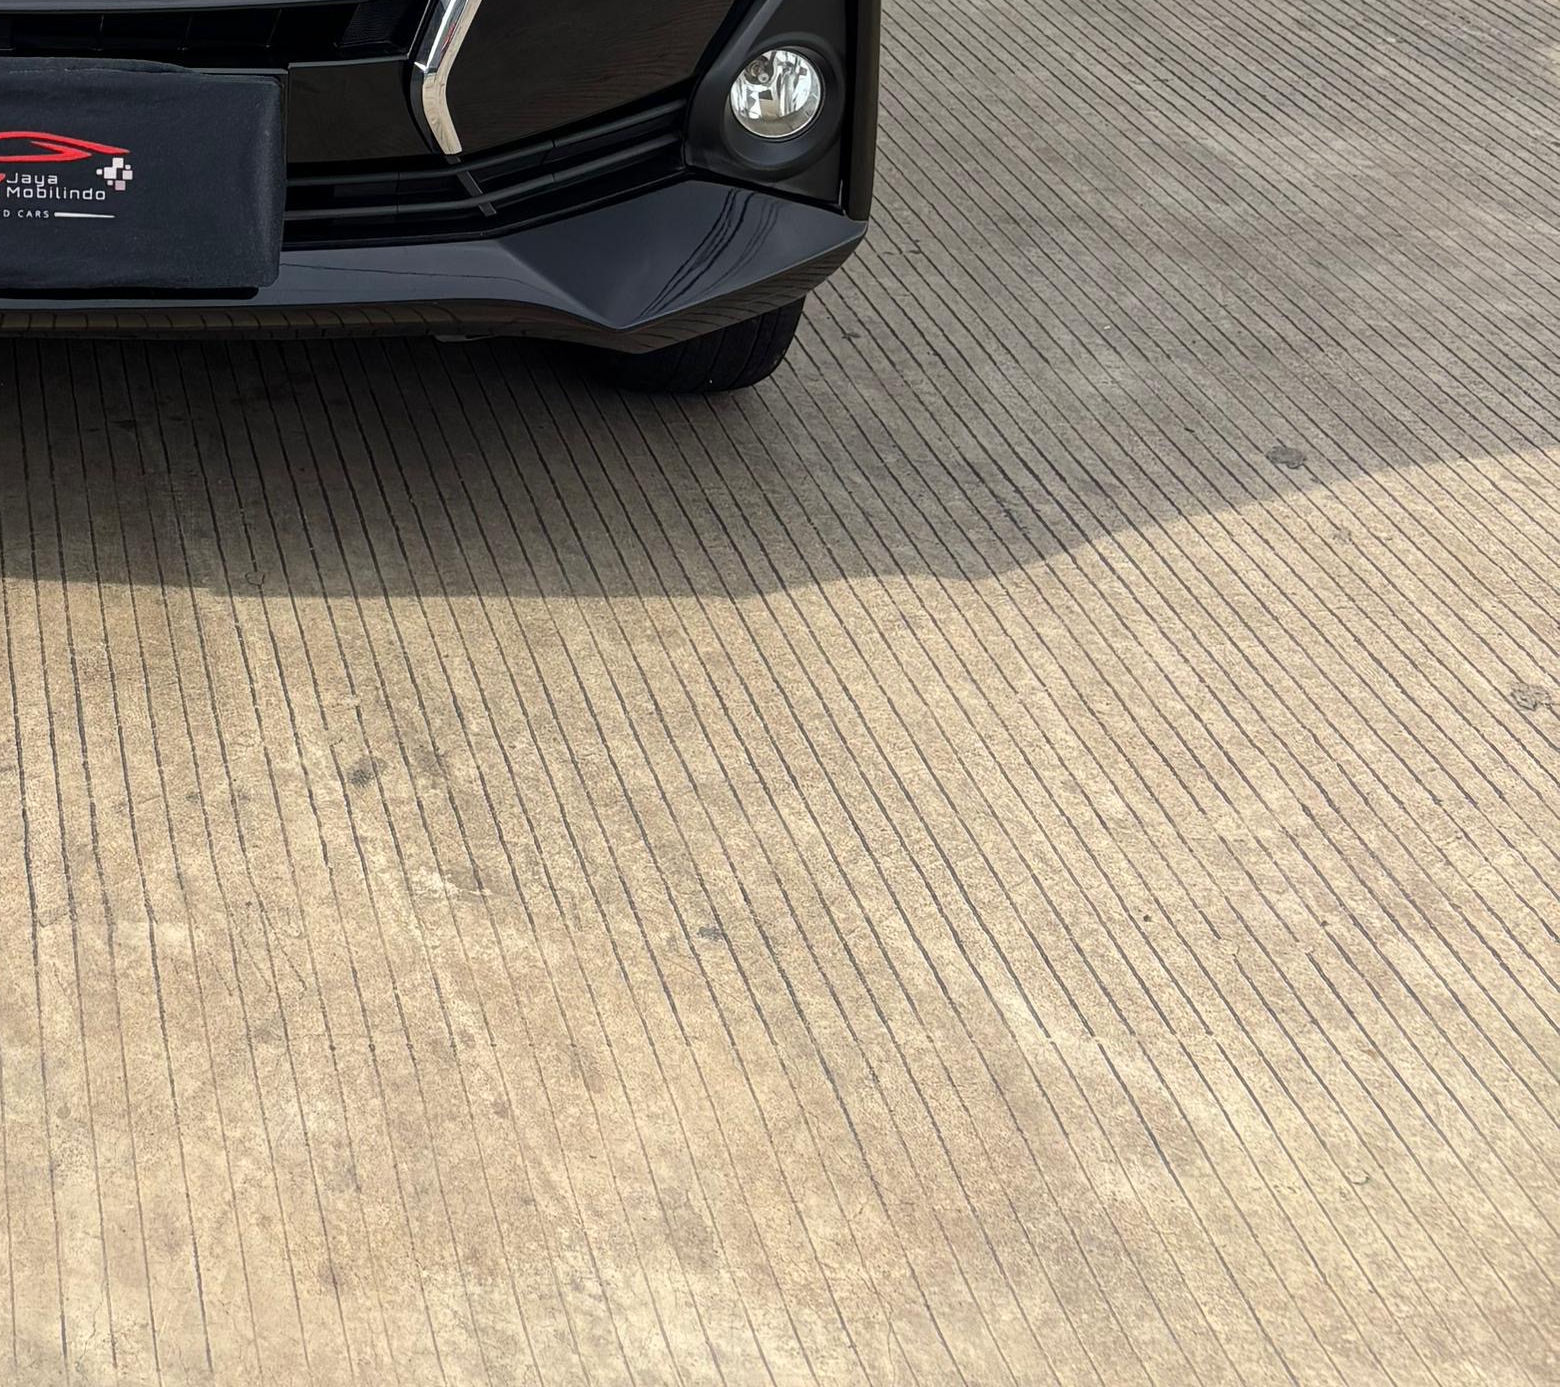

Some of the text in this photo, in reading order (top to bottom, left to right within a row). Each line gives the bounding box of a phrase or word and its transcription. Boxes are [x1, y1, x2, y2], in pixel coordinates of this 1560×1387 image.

[6, 173, 58, 189] Jaya
[6, 187, 106, 201] Mobilindo
[17, 210, 50, 218] CARS
